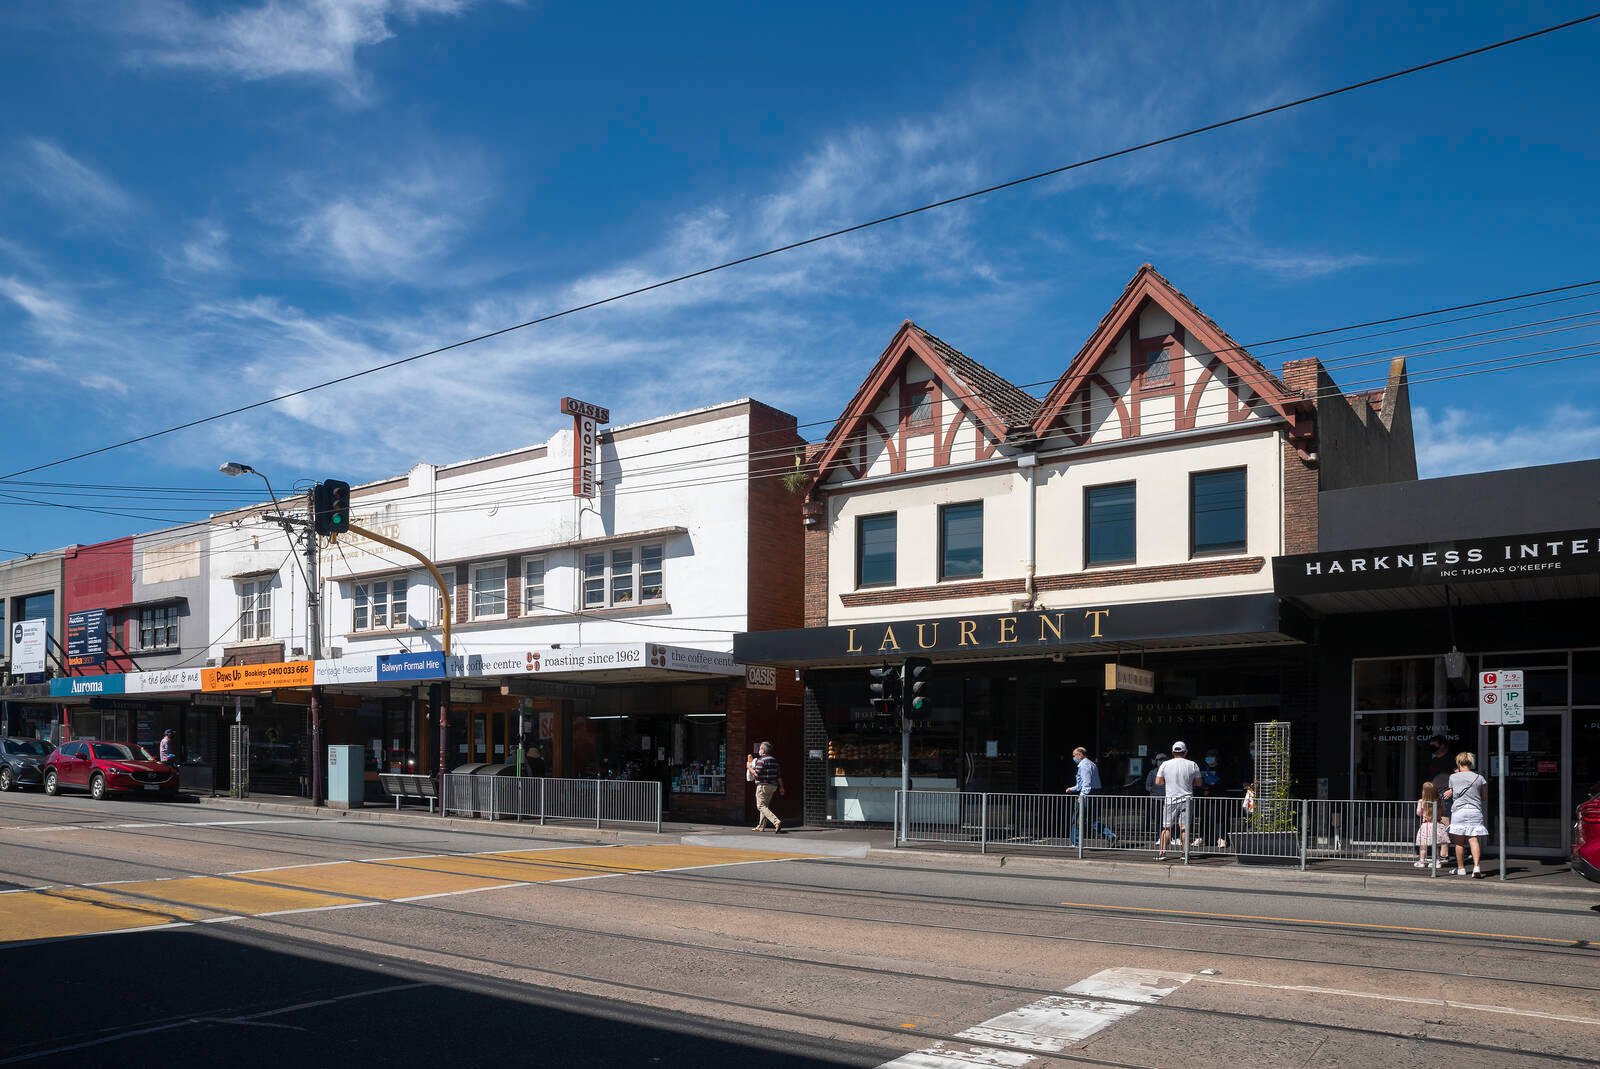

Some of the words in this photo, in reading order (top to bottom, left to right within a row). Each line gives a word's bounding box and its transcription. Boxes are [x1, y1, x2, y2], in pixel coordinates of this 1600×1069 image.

[568, 400, 609, 420] OASIS
[583, 421, 592, 495] COFFEE
[1306, 549, 1483, 576] HARKNESS
[1505, 538, 1600, 560] INTE
[1462, 566, 1505, 575] THOMAS
[1508, 562, 1562, 572] O'KEEFFE
[847, 609, 1109, 652] LAURENT
[544, 653, 585, 668] roasting
[587, 651, 614, 664] since
[616, 649, 640, 663] 1962
[671, 650, 686, 662] the
[688, 652, 712, 665] coffee
[316, 667, 341, 677] Heritage
[342, 665, 374, 674] Menswear
[381, 663, 402, 672] Balwyn
[403, 661, 425, 670] Formal
[426, 659, 440, 669] Hire
[451, 662, 464, 672] the
[466, 659, 491, 671] coffee
[493, 660, 522, 669] centre
[148, 676, 159, 685] the
[160, 671, 179, 685] baker
[181, 671, 186, 683] &
[187, 674, 199, 682] me
[216, 671, 232, 682] Paws
[232, 669, 242, 681] Up
[244, 670, 268, 678] Booking:
[268, 668, 282, 676] 0410
[296, 665, 309, 673] 666
[749, 667, 775, 685] OASIS
[71, 680, 103, 693] Auroma
[1506, 692, 1519, 701] 1P
